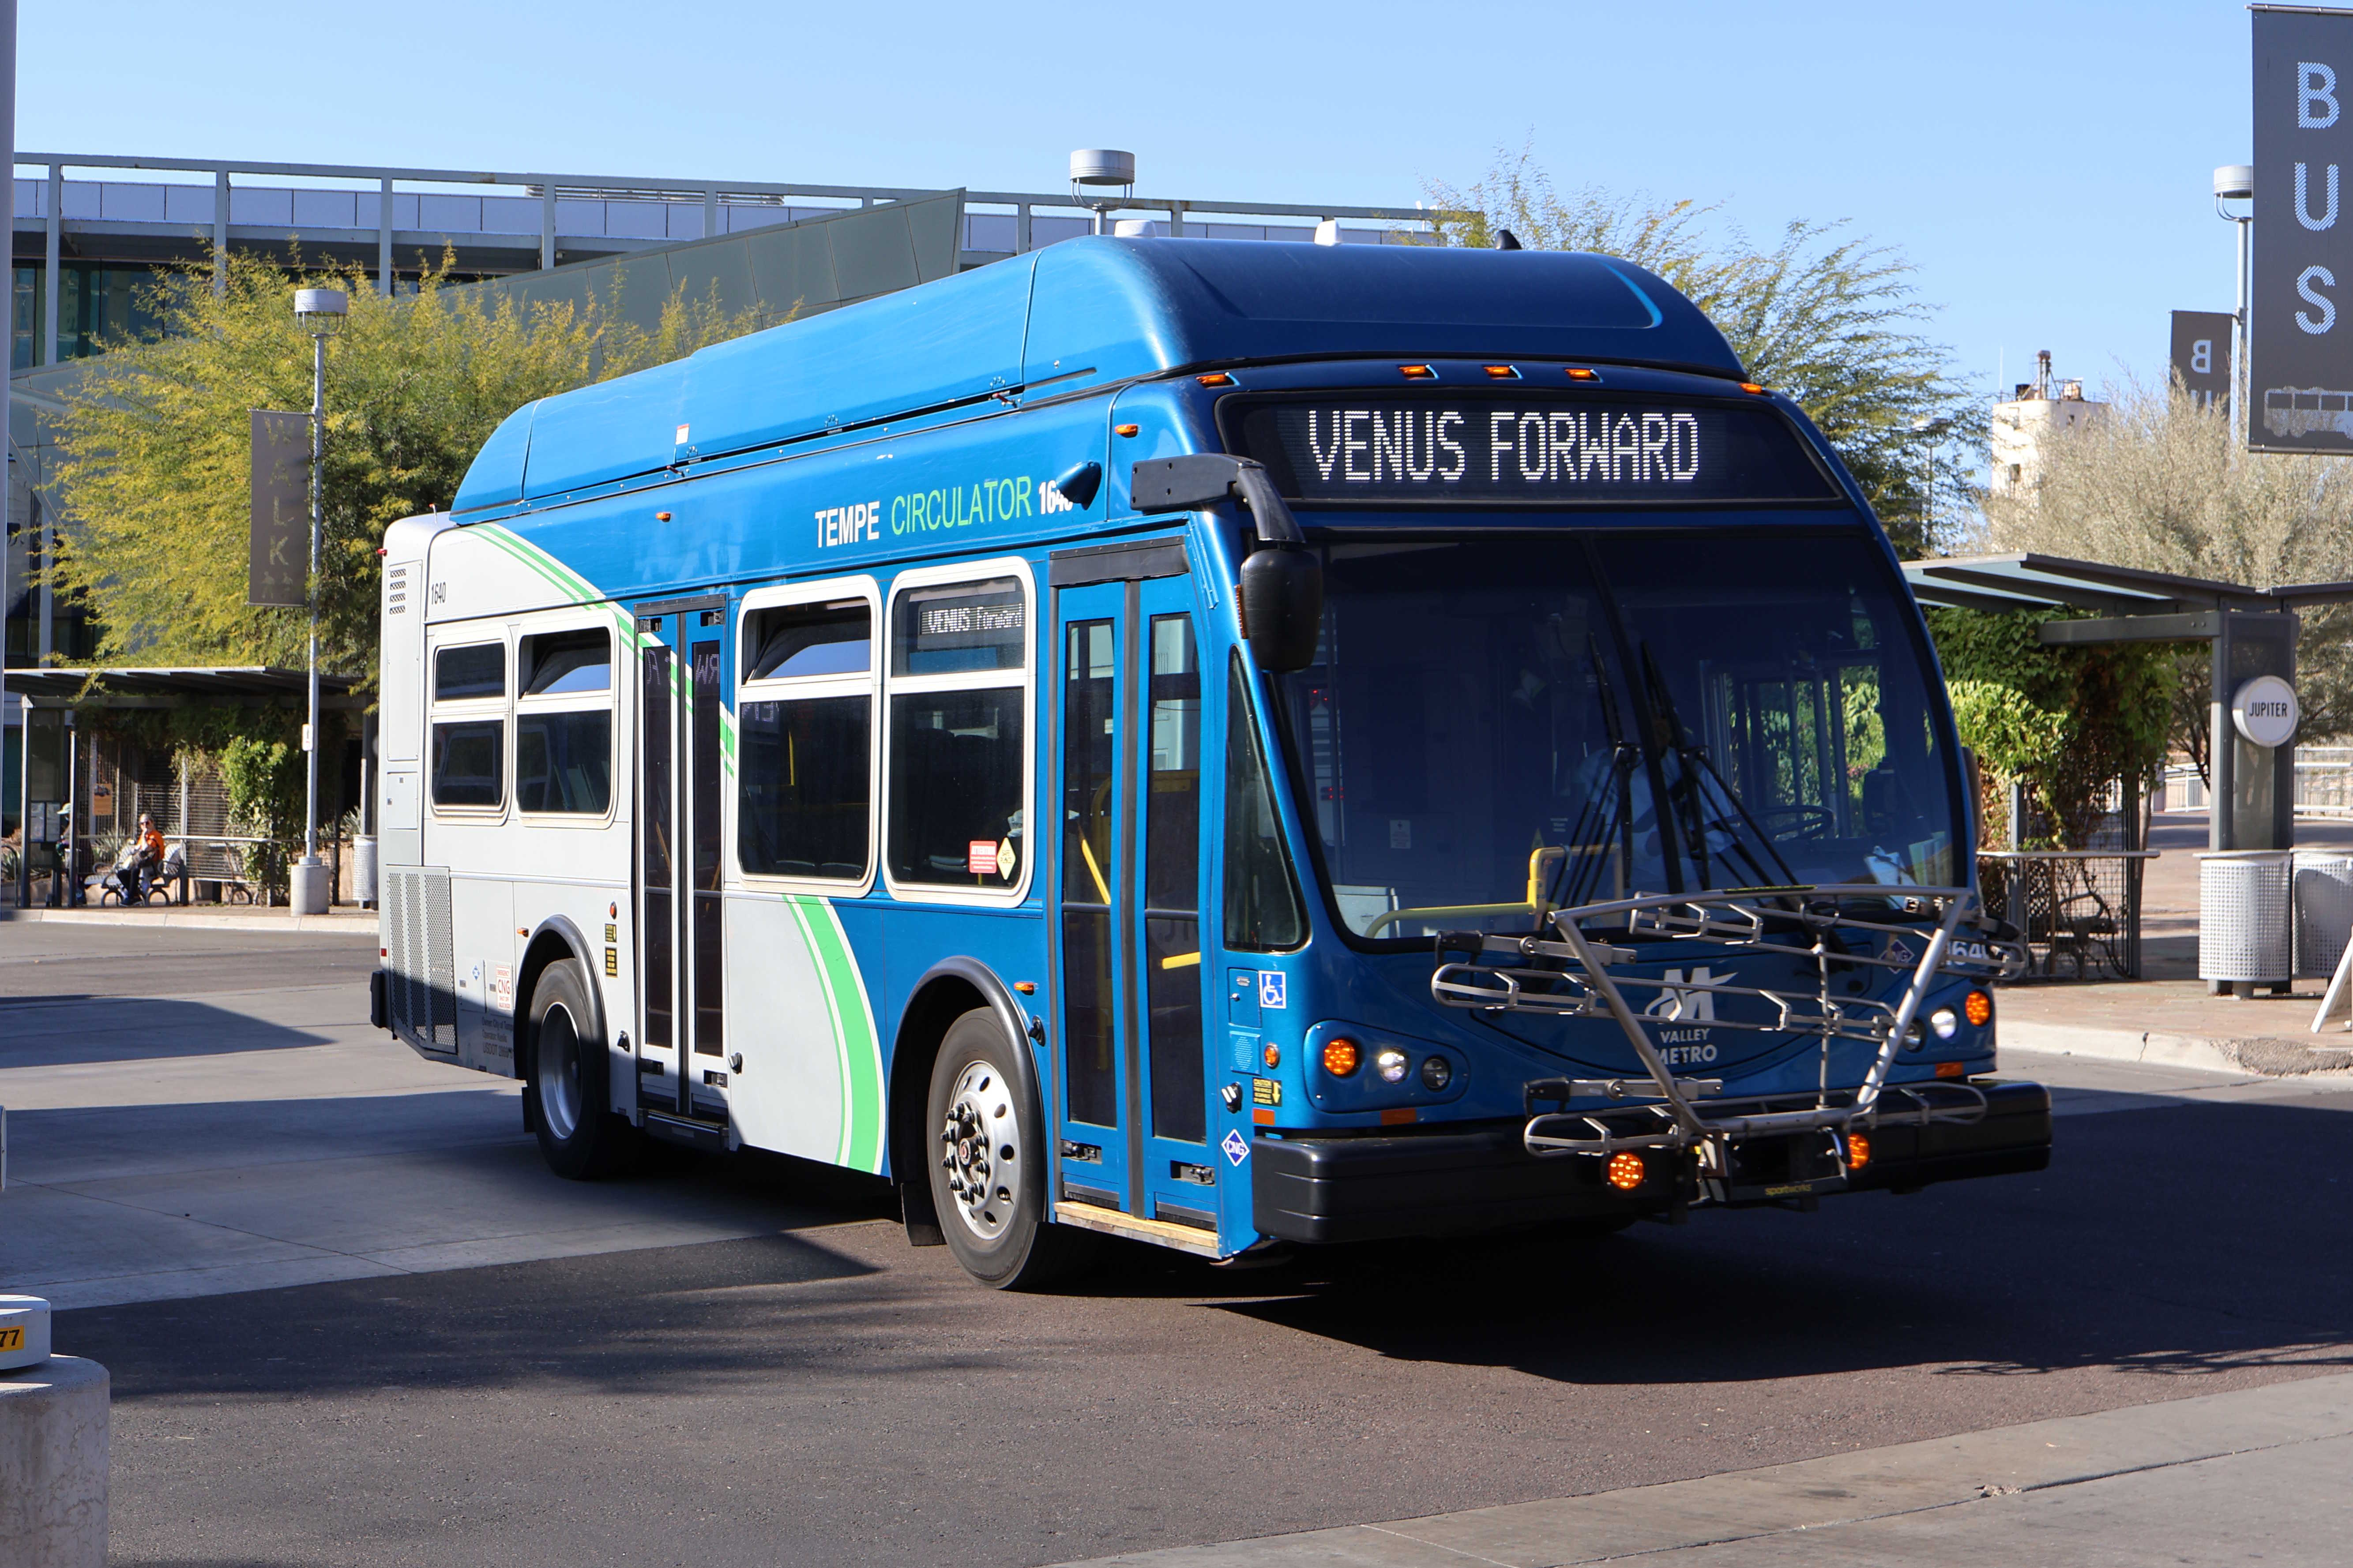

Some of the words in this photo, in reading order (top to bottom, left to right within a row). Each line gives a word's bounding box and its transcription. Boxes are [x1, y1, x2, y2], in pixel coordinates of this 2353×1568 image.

[2294, 61, 2340, 335] BUS
[1308, 410, 1466, 481] VENUS
[1490, 411, 1699, 481] FORWARD
[263, 416, 296, 566] WALK
[814, 501, 880, 548] TEMPE
[891, 476, 1033, 535] CIRCULATOR
[431, 581, 446, 605] 1640
[928, 607, 970, 633] VENUS
[976, 603, 1022, 630] Forward
[2249, 701, 2288, 717] JUPITER
[497, 979, 511, 995] CNG
[1660, 1028, 1711, 1043] VALLEY
[1655, 1044, 1718, 1065] METRO
[1226, 1140, 1245, 1155] CNG
[0, 1329, 20, 1347] 77
